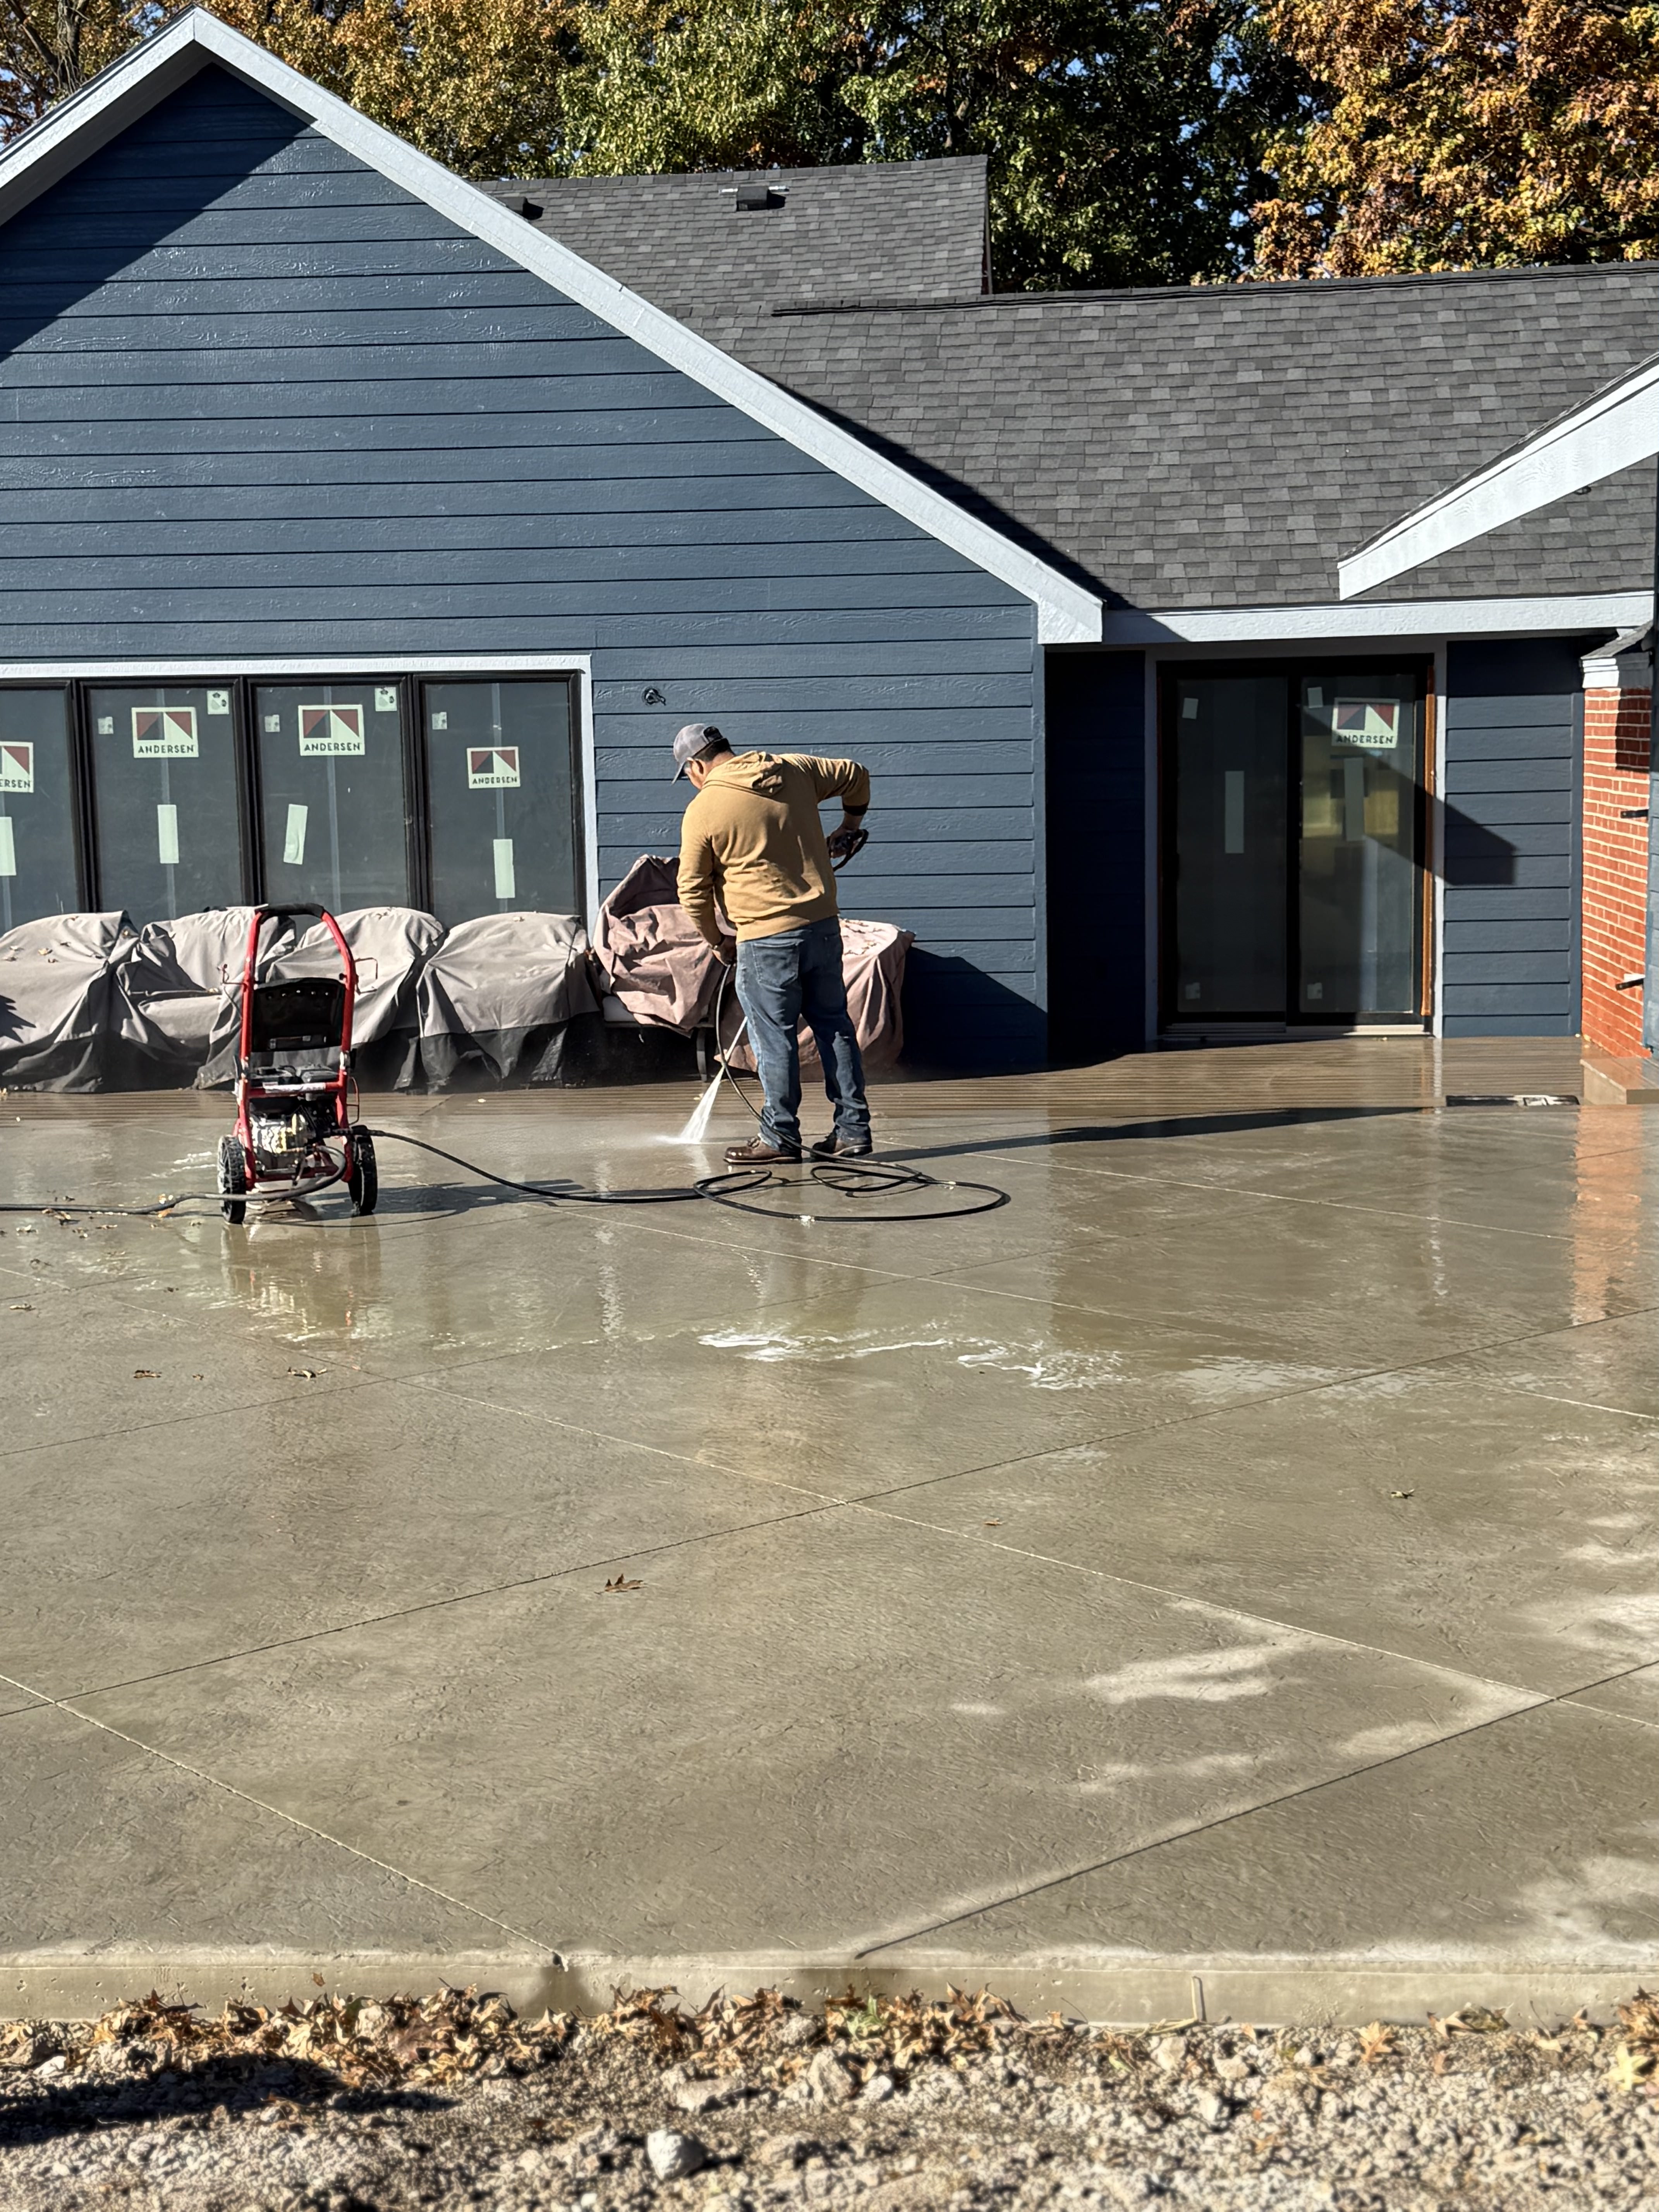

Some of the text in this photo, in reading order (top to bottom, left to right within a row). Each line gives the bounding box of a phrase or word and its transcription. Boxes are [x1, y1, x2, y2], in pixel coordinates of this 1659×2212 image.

[1337, 735, 1393, 744] ANDERSEN
[138, 744, 194, 754] ANDERSEN
[304, 742, 360, 751] ANDERSEN
[0, 779, 31, 788] ERSEN
